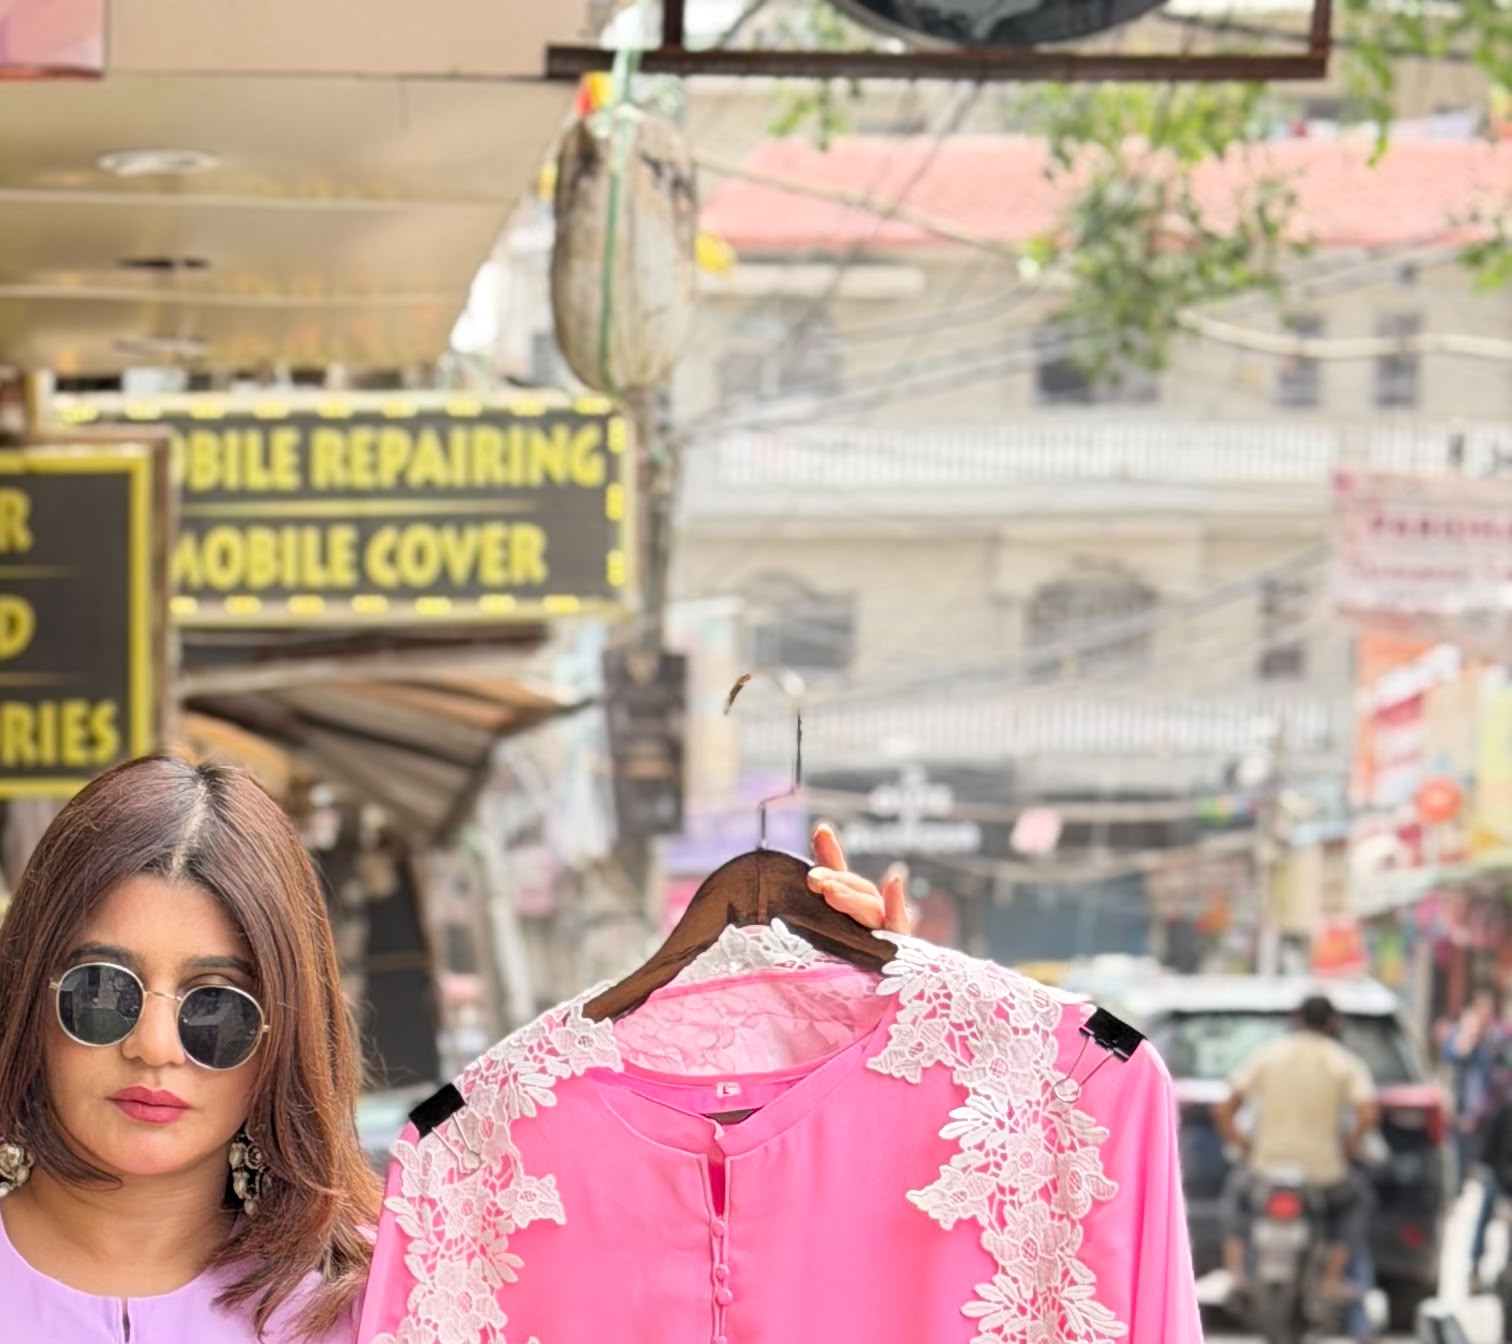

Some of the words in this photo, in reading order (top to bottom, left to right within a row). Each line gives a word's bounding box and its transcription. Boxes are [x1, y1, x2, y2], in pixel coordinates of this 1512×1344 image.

[175, 427, 301, 493] BILE
[310, 422, 607, 488] REPAIRING
[364, 520, 548, 587] COVER
